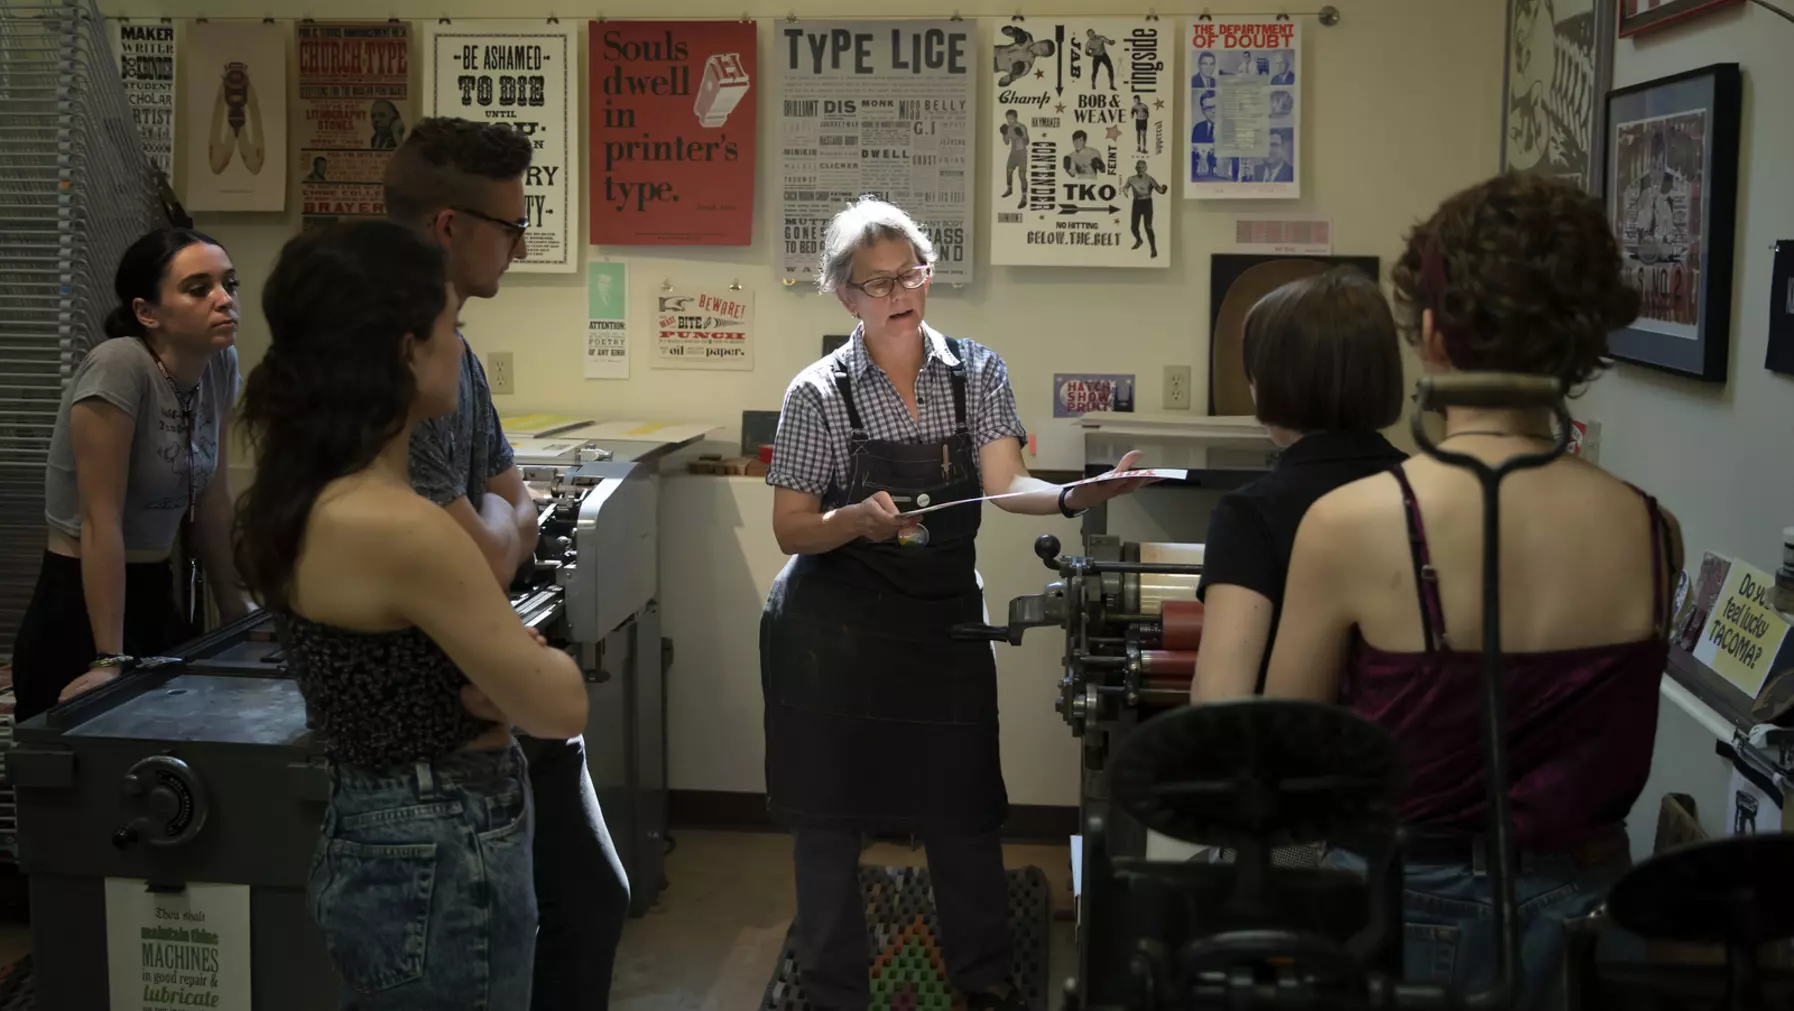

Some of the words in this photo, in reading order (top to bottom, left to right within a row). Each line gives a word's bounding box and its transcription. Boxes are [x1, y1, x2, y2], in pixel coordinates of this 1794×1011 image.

[121, 26, 173, 40] MAKER
[1193, 24, 1215, 34] THE
[1219, 24, 1294, 35] DEPARTMENT
[121, 43, 174, 54] WRITER
[603, 31, 689, 61] Souls
[1192, 34, 1219, 48] OF
[1224, 34, 1294, 48] DOUBT
[300, 41, 361, 74] CHURCH
[365, 41, 407, 74] TYPE
[463, 46, 478, 70] BE
[484, 46, 542, 70] ASHAMED
[784, 29, 873, 74] TYPE
[892, 29, 966, 74] LICE
[1070, 37, 1081, 78] JAB
[1124, 28, 1163, 92] ringside
[458, 75, 493, 106] TO
[499, 75, 545, 106] DIE
[603, 66, 691, 96] dwell
[129, 93, 172, 105] CHOLAR
[824, 100, 856, 114] DIS
[925, 100, 966, 110] BELLY
[998, 90, 1051, 109] Champ
[1078, 94, 1106, 108] BOB
[1109, 94, 1120, 108] &
[133, 108, 172, 124] RTIST
[604, 100, 636, 128] in
[899, 100, 920, 120] MISS
[1074, 109, 1127, 123] WEAVE
[604, 133, 738, 172] printer's
[862, 149, 910, 158] DWELL
[1107, 145, 1117, 176] FEINT
[1030, 142, 1056, 211] CONTENDER
[604, 176, 679, 212] type.
[1063, 184, 1116, 201] TKO
[785, 227, 817, 239] GONE
[785, 241, 797, 254] TO
[800, 241, 817, 254] BED
[940, 245, 964, 261] ND
[699, 294, 746, 318] BEWARE!
[678, 316, 702, 329] BITE
[670, 346, 684, 355] oil
[706, 347, 744, 357] paper.
[1068, 382, 1110, 392] HATCH
[1068, 392, 1109, 402] SHOW
[1738, 573, 1755, 599] Do
[1722, 596, 1742, 626] feel
[1740, 605, 1770, 638] lucky
[1708, 619, 1762, 669] TACOMA?
[156, 907, 180, 920] Thou
[183, 910, 206, 922] shalt
[142, 942, 219, 973] MACHINES
[142, 968, 151, 982] in
[154, 970, 177, 984] good
[180, 972, 207, 988] repair
[210, 974, 218, 988] &
[143, 984, 219, 1007] lubricate
